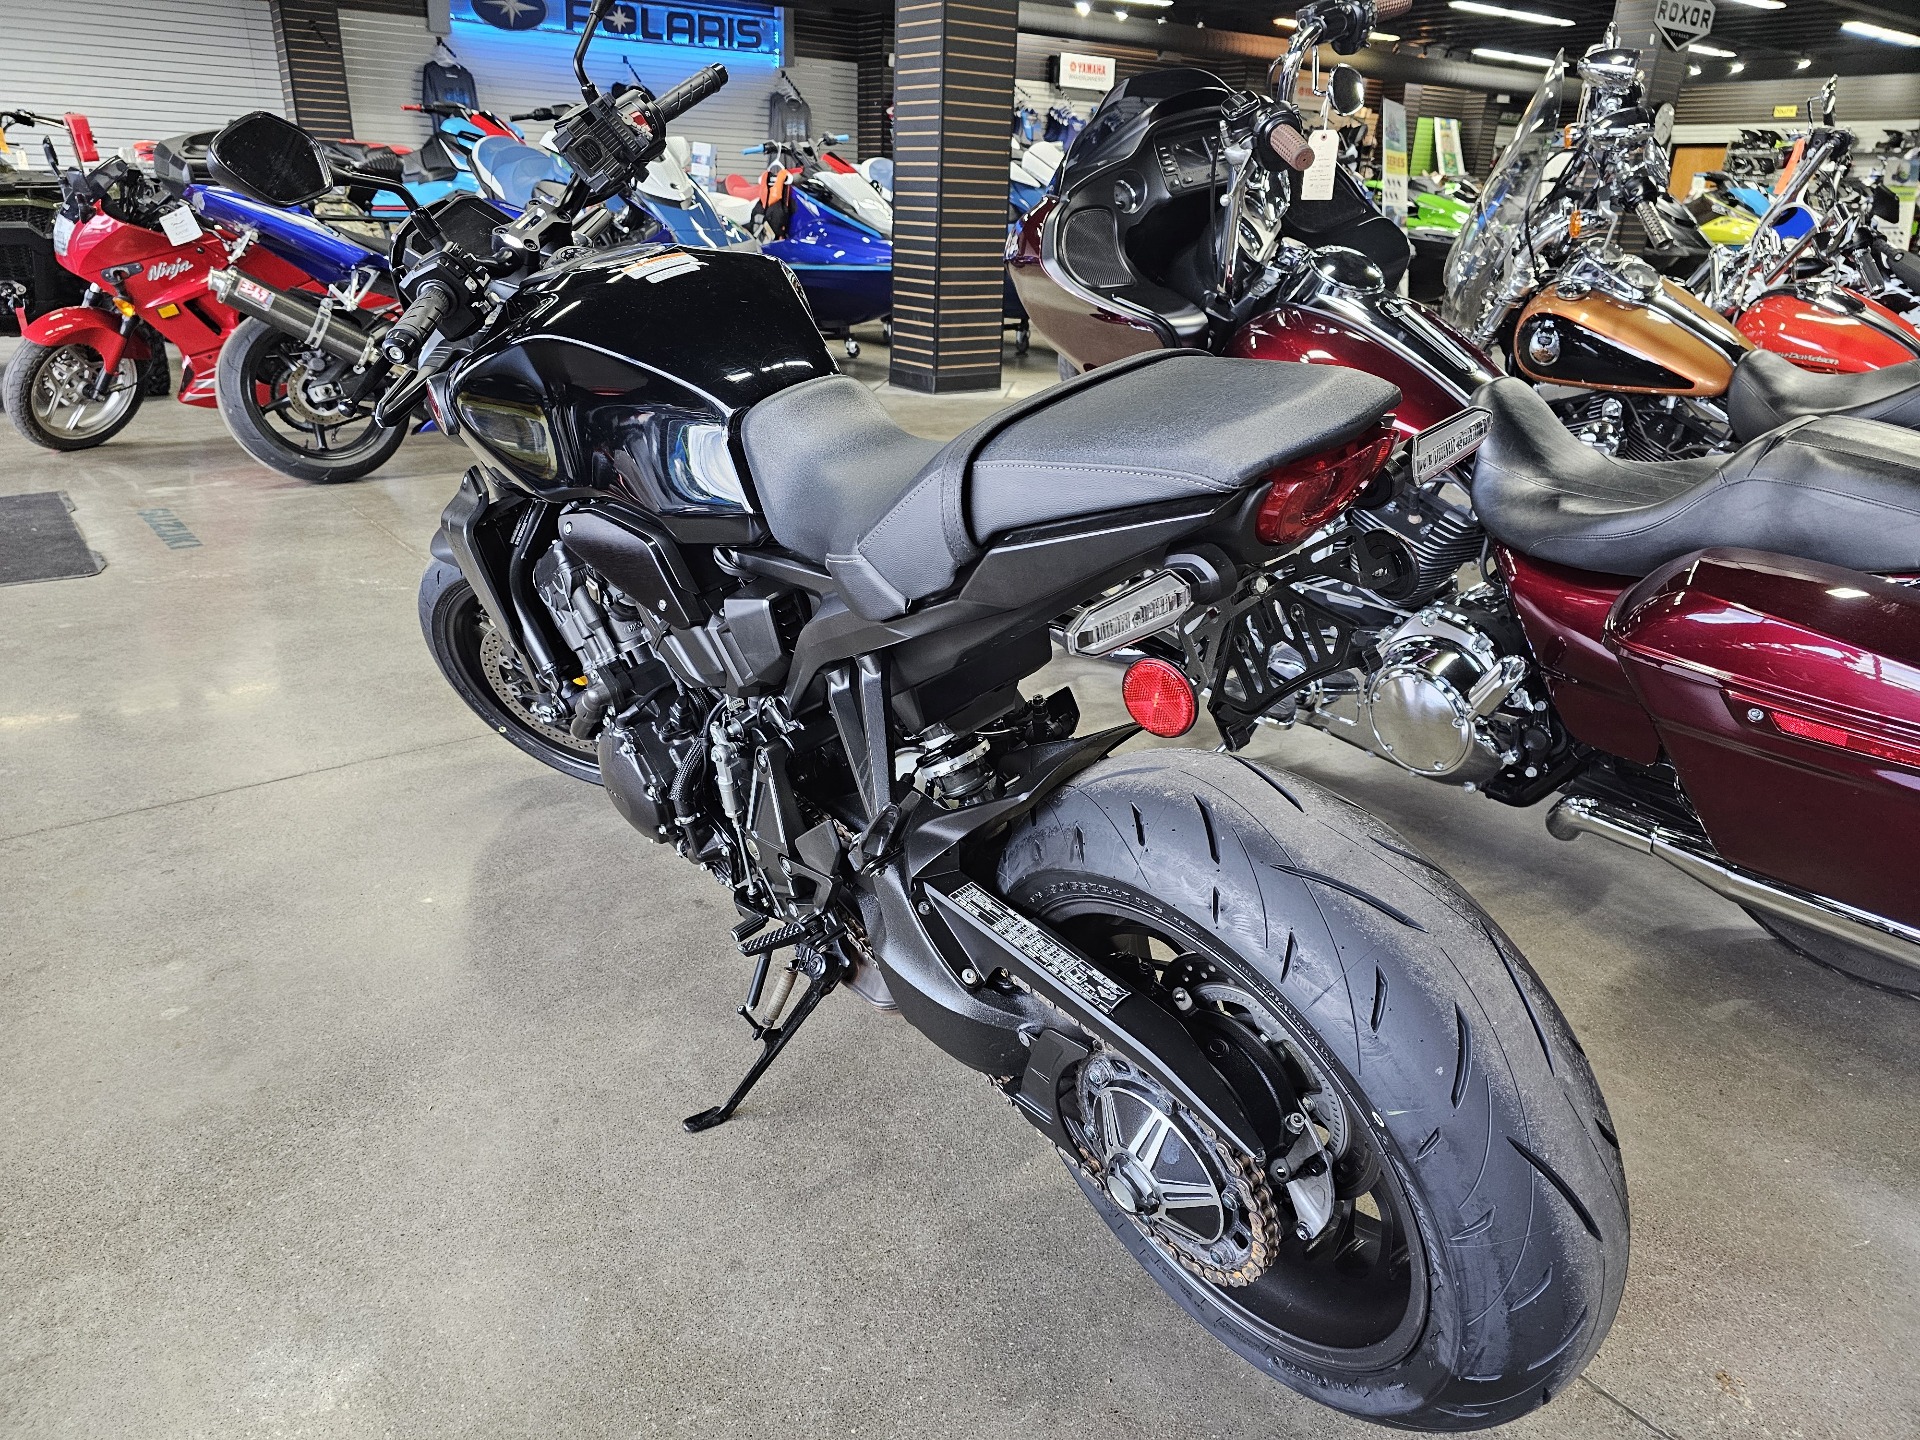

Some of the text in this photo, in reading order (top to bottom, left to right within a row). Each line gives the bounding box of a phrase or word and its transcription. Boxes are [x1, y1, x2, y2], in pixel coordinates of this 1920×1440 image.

[566, 0, 762, 48] POLARIS
[1658, 0, 1711, 29] ROXOR
[1078, 62, 1106, 75] YAMAHA
[147, 257, 194, 282] Ninja
